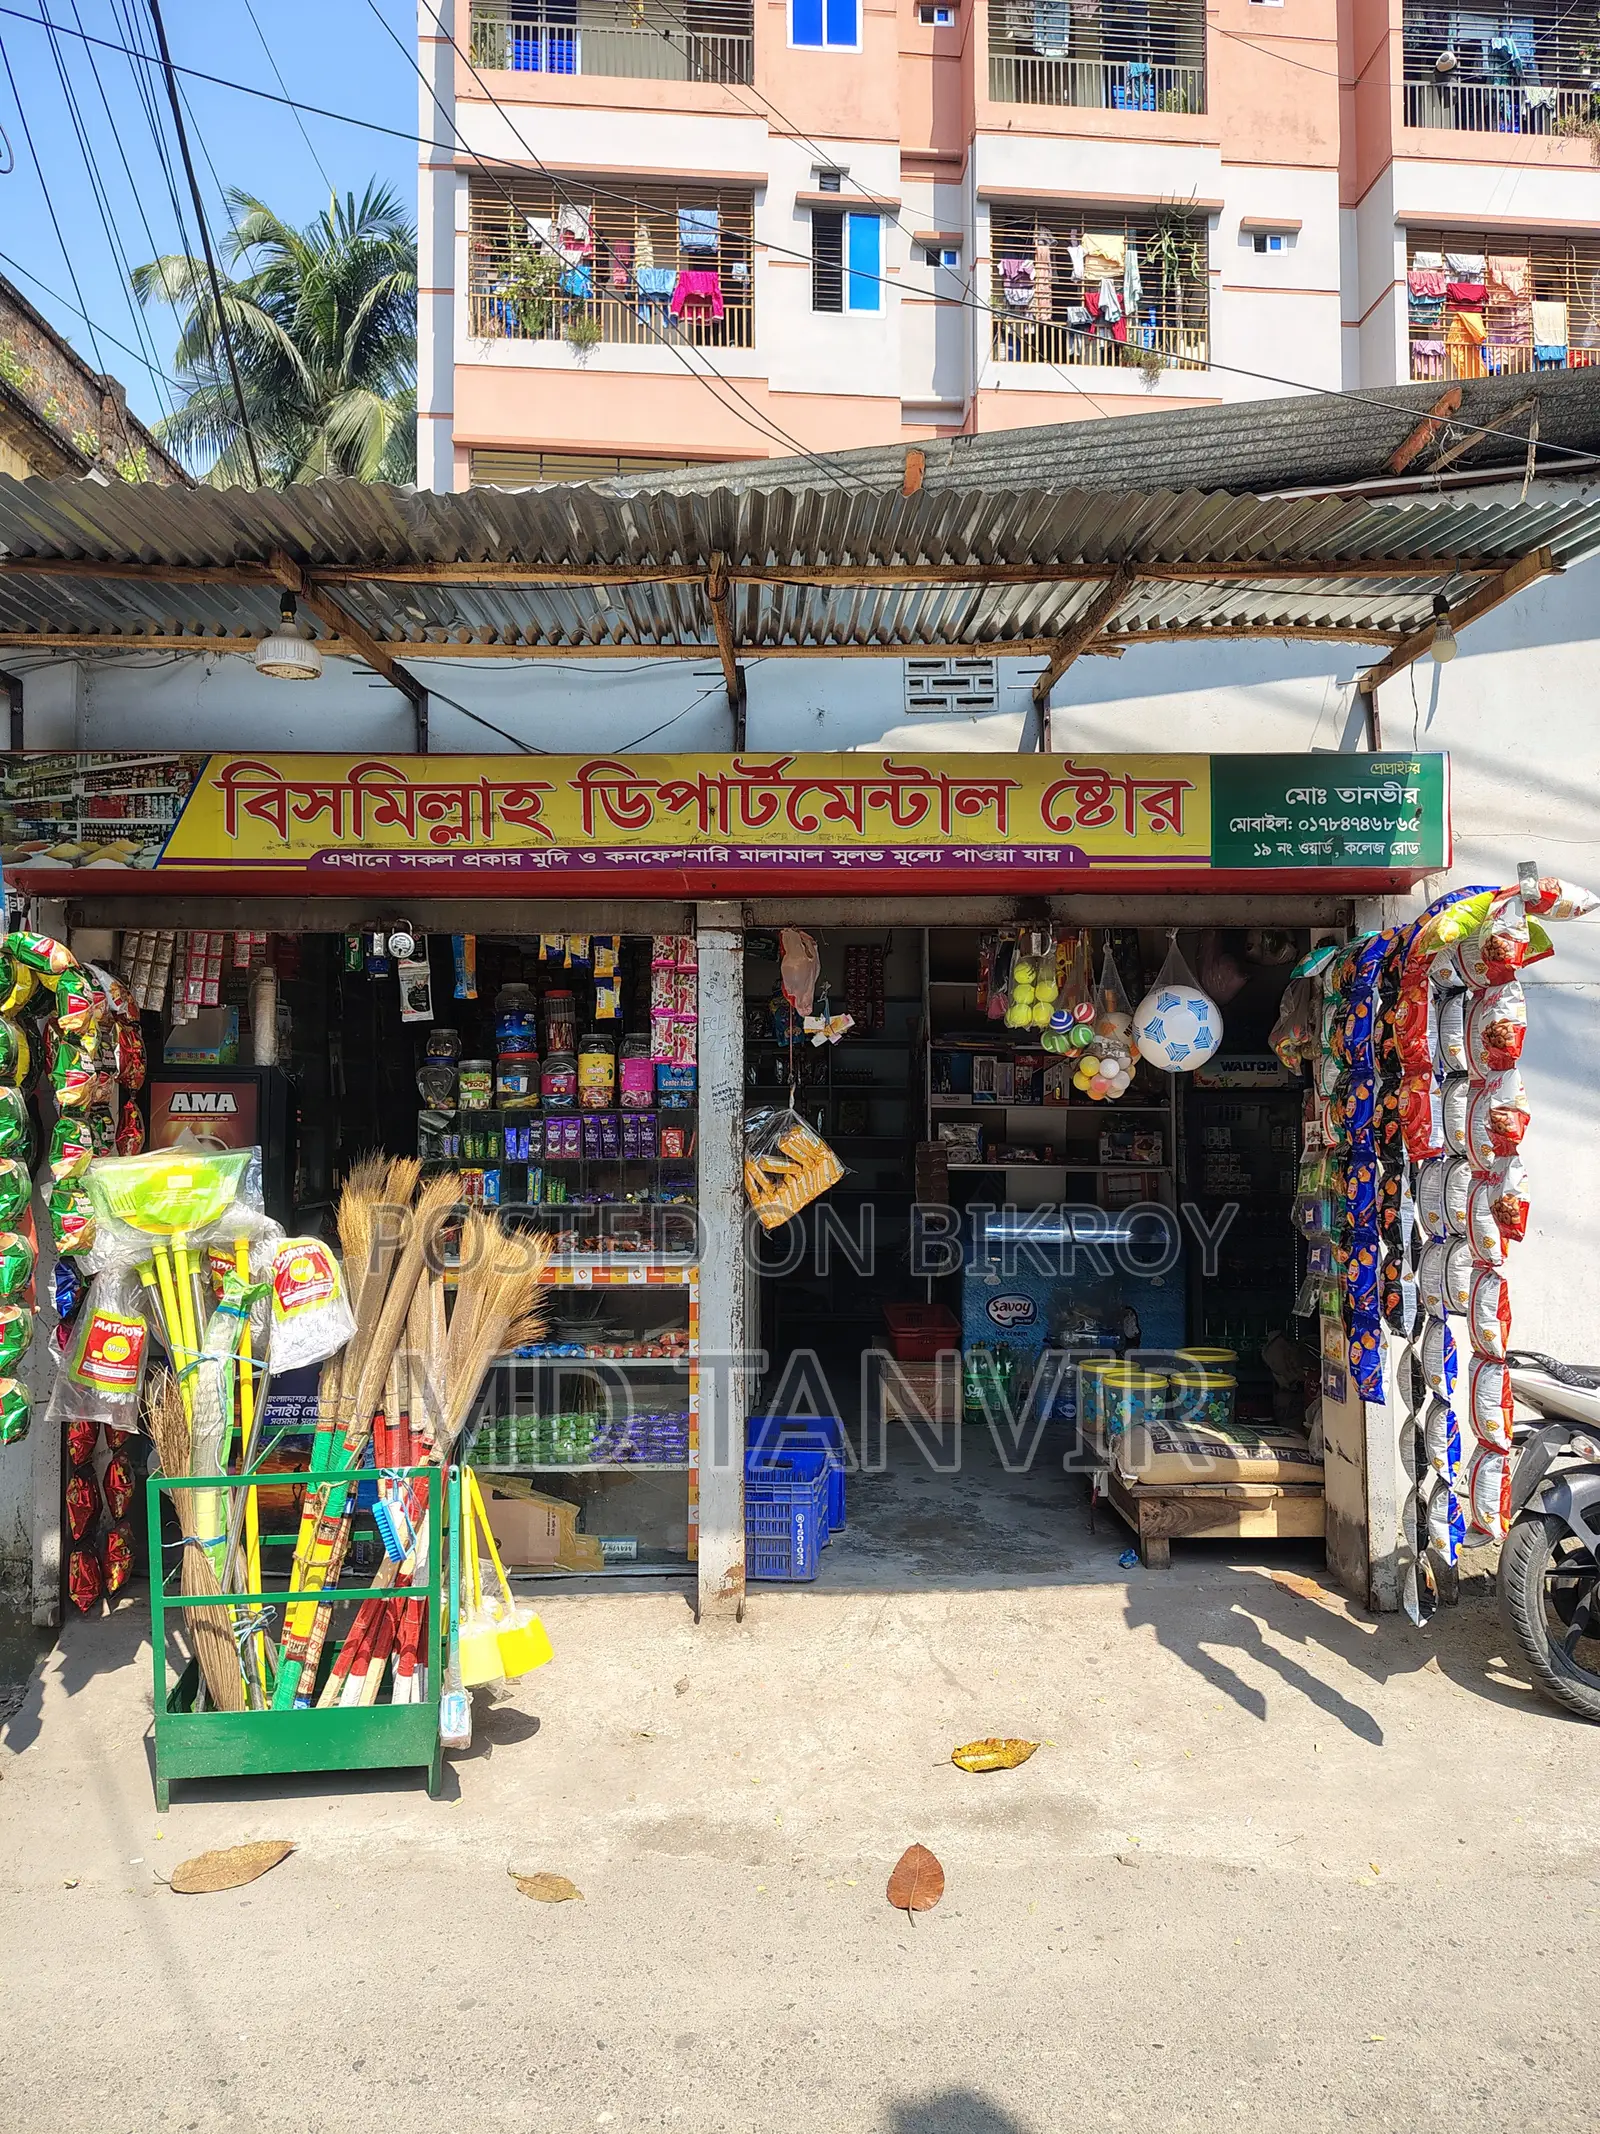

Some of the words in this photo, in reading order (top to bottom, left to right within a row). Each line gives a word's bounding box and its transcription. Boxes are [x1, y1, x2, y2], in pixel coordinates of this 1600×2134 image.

[211, 758, 557, 845] বিসমিল্লাহ
[567, 755, 1022, 837] ডিপার্টমেন্টাল
[1040, 759, 1196, 837] ষ্টোর
[1285, 785, 1328, 806] মোঃ
[1334, 780, 1421, 806] তানভীর
[321, 851, 392, 868] এখানে
[398, 852, 456, 868] সকল
[461, 851, 521, 867] প্রকার
[530, 848, 570, 867] মুদি
[578, 851, 597, 865] ও
[739, 849, 826, 864] মালামাল
[832, 849, 885, 866] সুলভ
[951, 849, 1018, 864] পাওয়া
[1253, 840, 1272, 858] ১৯
[1276, 841, 1295, 858] নং
[1343, 841, 1386, 857] কলেজ
[1389, 841, 1421, 856] রোড
[1220, 1060, 1278, 1072] WALTON
[169, 1092, 238, 1113] AMA
[992, 1300, 1032, 1315] Savoy
